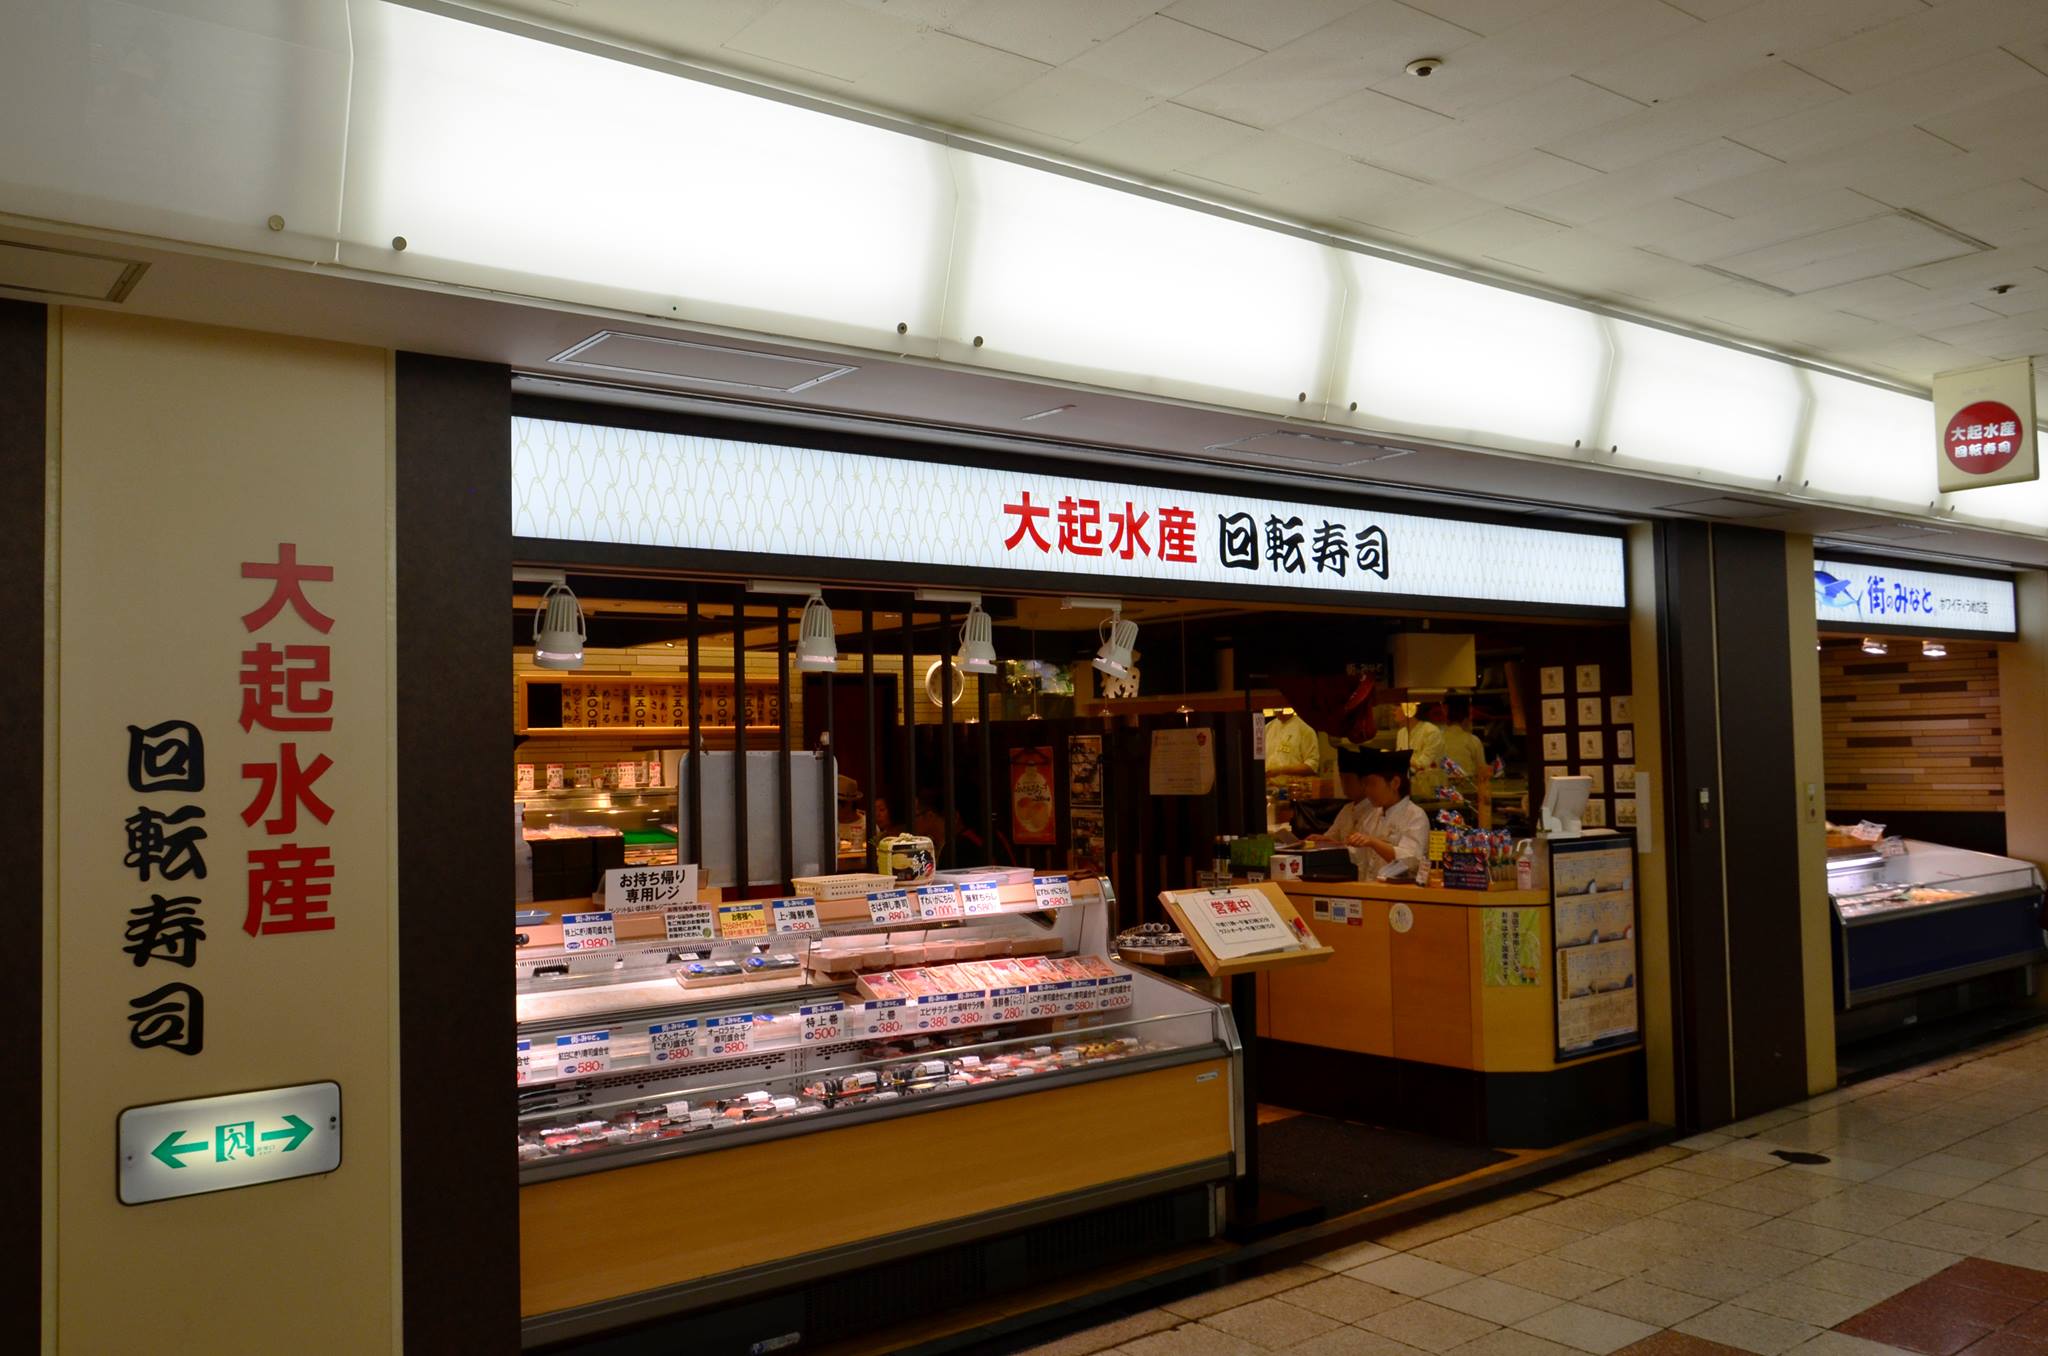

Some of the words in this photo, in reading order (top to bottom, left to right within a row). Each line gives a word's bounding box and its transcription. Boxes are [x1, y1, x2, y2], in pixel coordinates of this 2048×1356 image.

[1951, 421, 2016, 441] 大起水産
[1954, 441, 2011, 458] 回転寿司
[1003, 490, 1198, 564] 大起水産
[1218, 511, 1390, 580] 回転寿司
[1867, 576, 1933, 614] 街のみなと
[238, 543, 336, 938] 大起水産
[620, 869, 685, 888] お持ち帰り
[122, 719, 207, 1056] 回転寿司
[626, 886, 680, 903] 専用レジ
[965, 892, 997, 903] 海鮮ちらし
[871, 898, 909, 913] さば押し寿司
[1211, 898, 1252, 915] 営業中
[731, 912, 754, 922] お客様へ
[580, 937, 609, 949] 1980
[806, 1014, 838, 1028] 特上巻
[960, 1012, 979, 1024] 380
[707, 1025, 752, 1035] オーロラサーモン
[814, 1026, 836, 1040] 500
[879, 1021, 899, 1033] 380
[651, 1029, 697, 1043] まぐろとサーモン
[668, 1047, 690, 1060] 580
[724, 1041, 744, 1053] 580
[577, 1060, 600, 1073] 580
